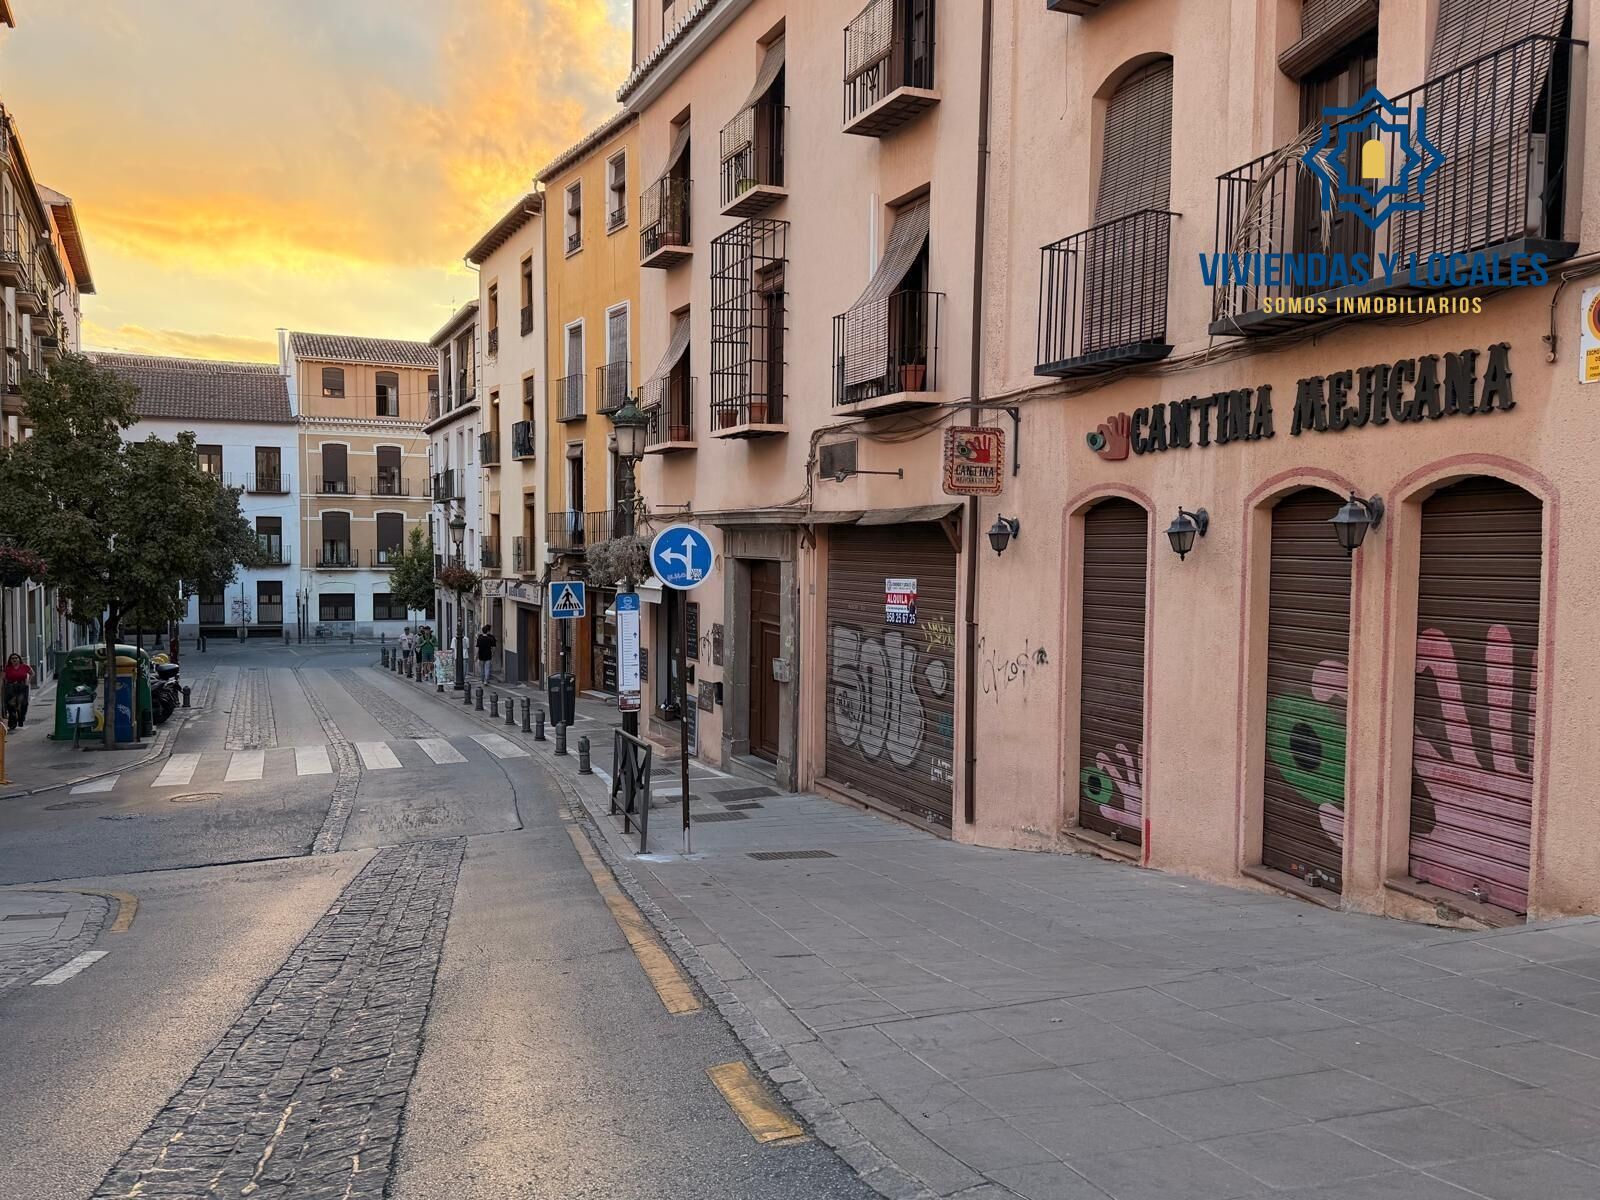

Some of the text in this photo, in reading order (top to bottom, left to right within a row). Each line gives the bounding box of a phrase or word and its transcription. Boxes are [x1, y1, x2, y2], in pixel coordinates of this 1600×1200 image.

[1131, 341, 1516, 455] CANTINA MEJICANA
[955, 464, 994, 477] CANTINA
[887, 594, 908, 604] ALQUILA
[895, 613, 902, 623] 25
[909, 614, 916, 624] 25
